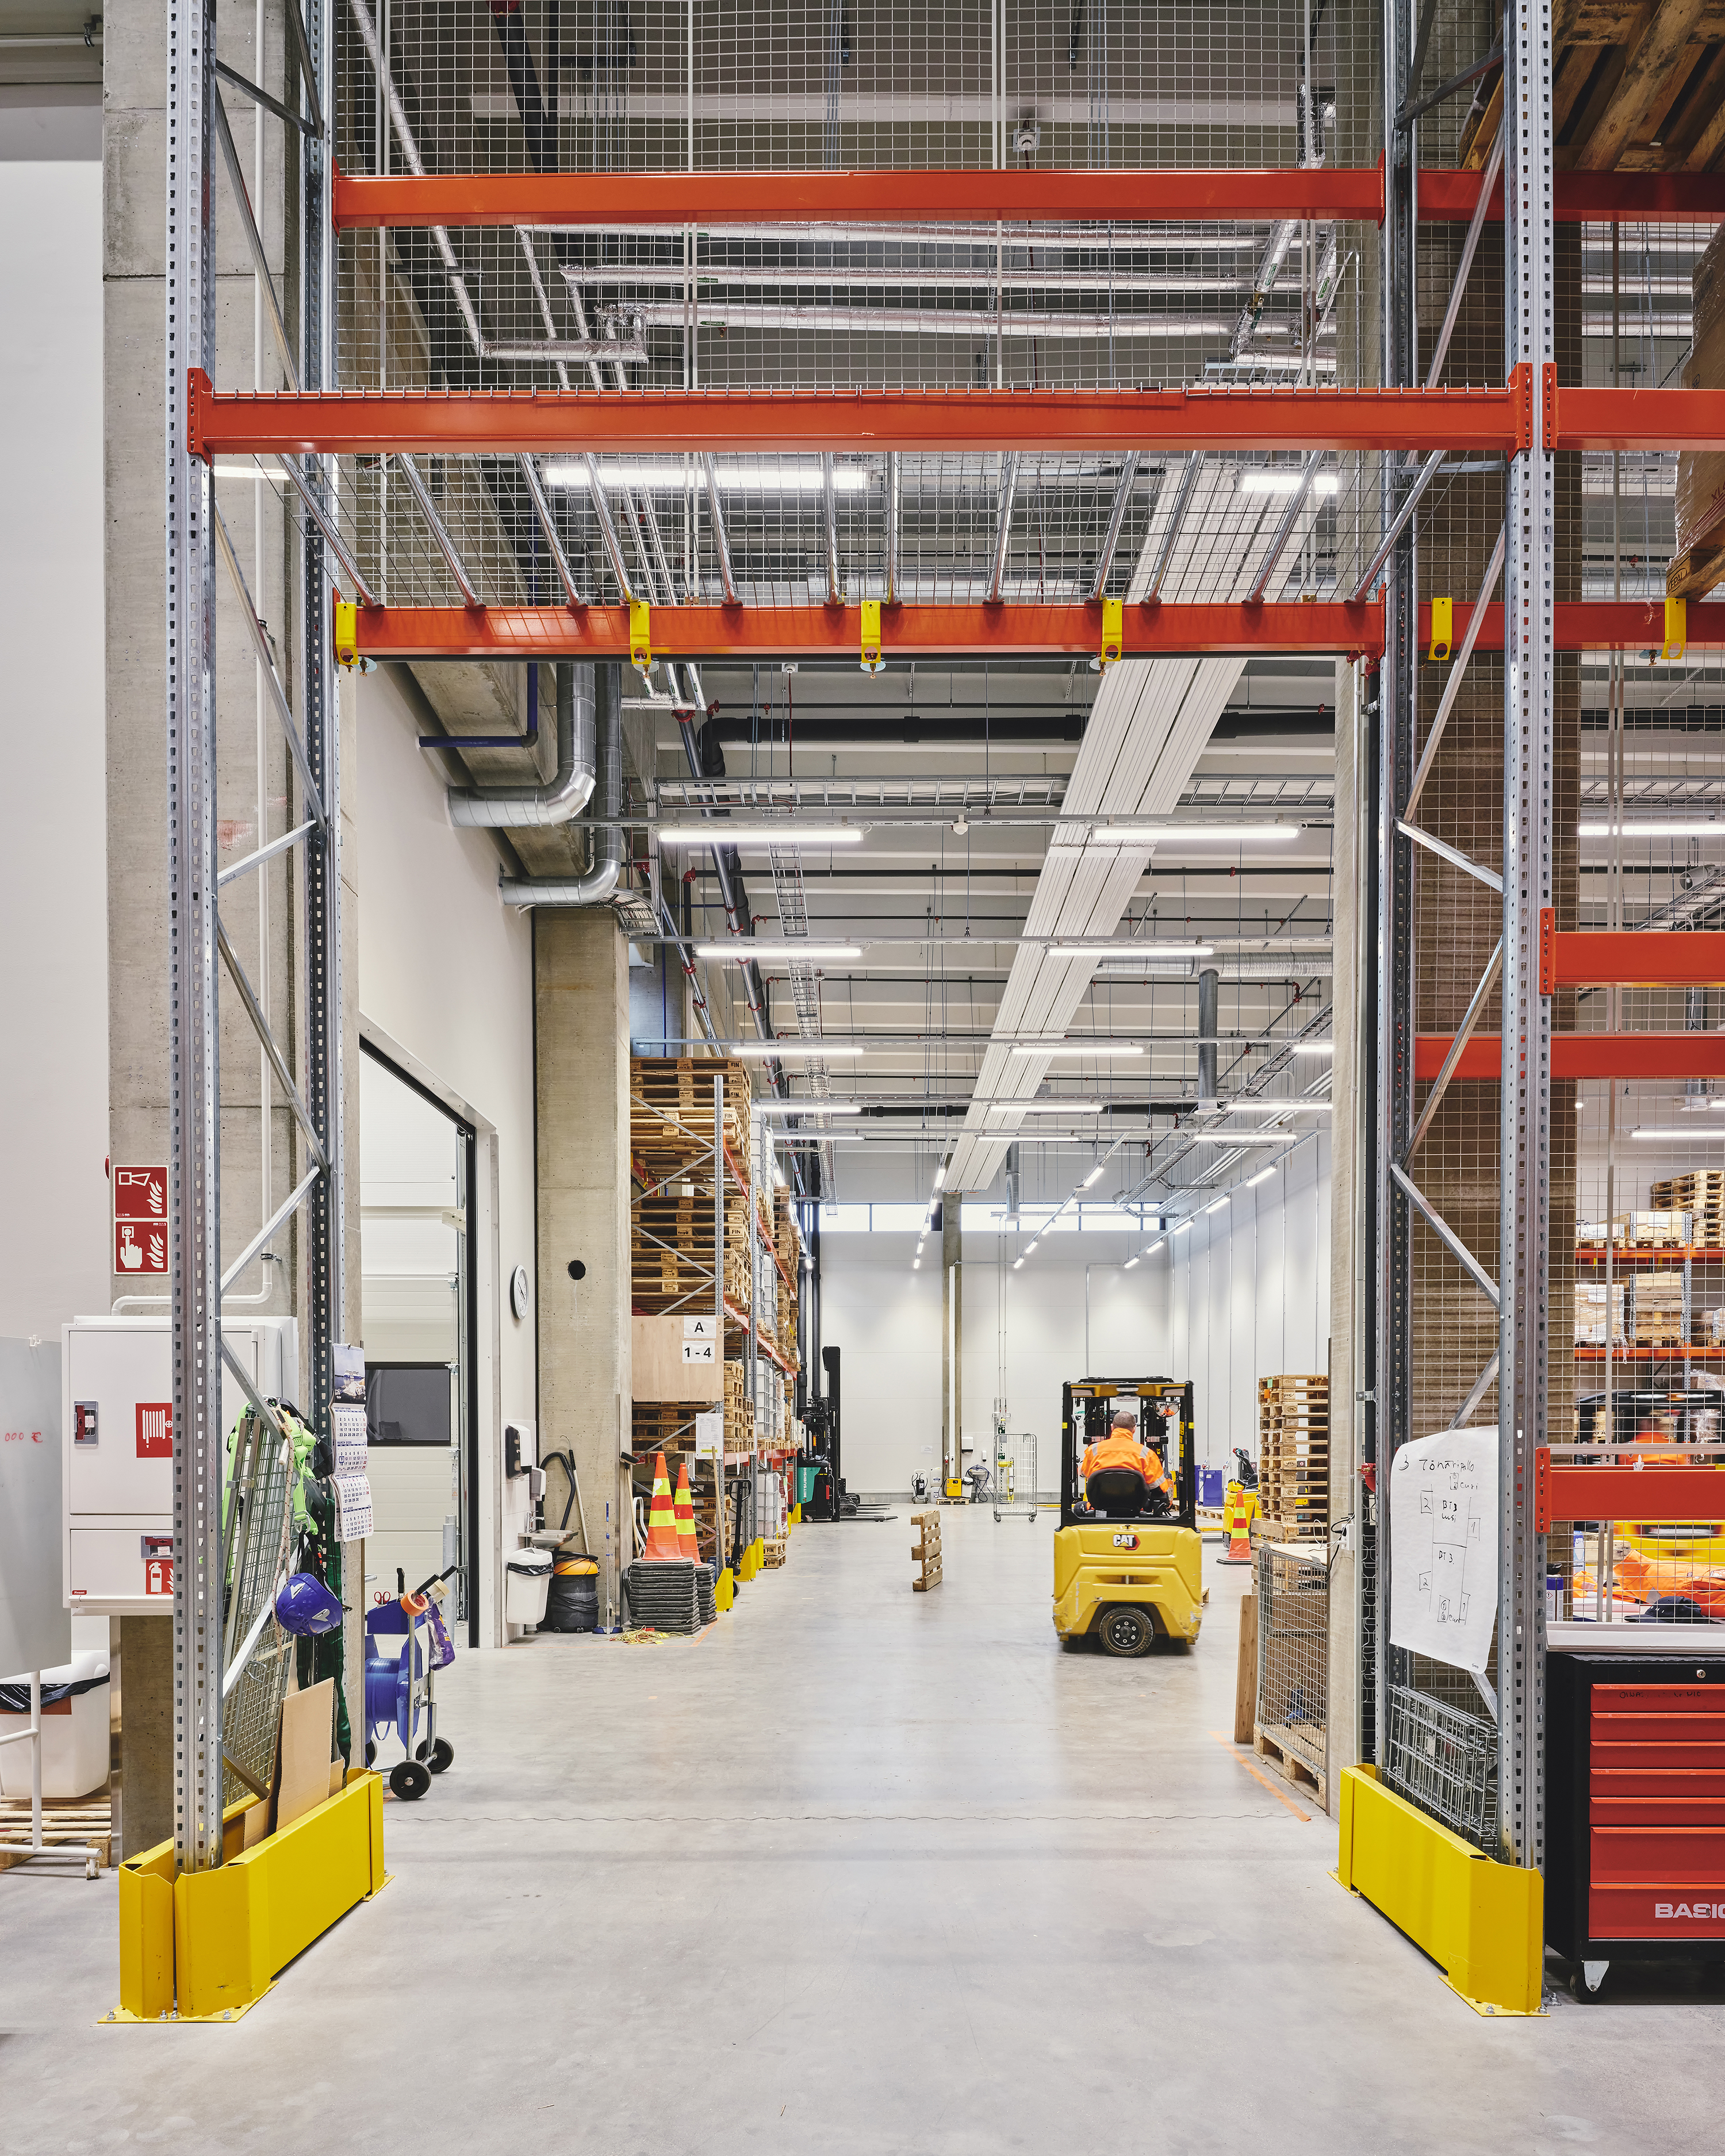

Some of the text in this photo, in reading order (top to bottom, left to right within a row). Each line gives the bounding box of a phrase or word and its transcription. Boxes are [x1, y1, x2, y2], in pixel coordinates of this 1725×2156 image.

[694, 1322, 704, 1332] A
[684, 1348, 690, 1357] 1
[703, 1348, 711, 1357] 4
[5, 1432, 43, 1443] 000 €
[1398, 1454, 1409, 1471] 3
[1424, 1498, 1432, 1511] 2
[1113, 1534, 1134, 1547] CAT
